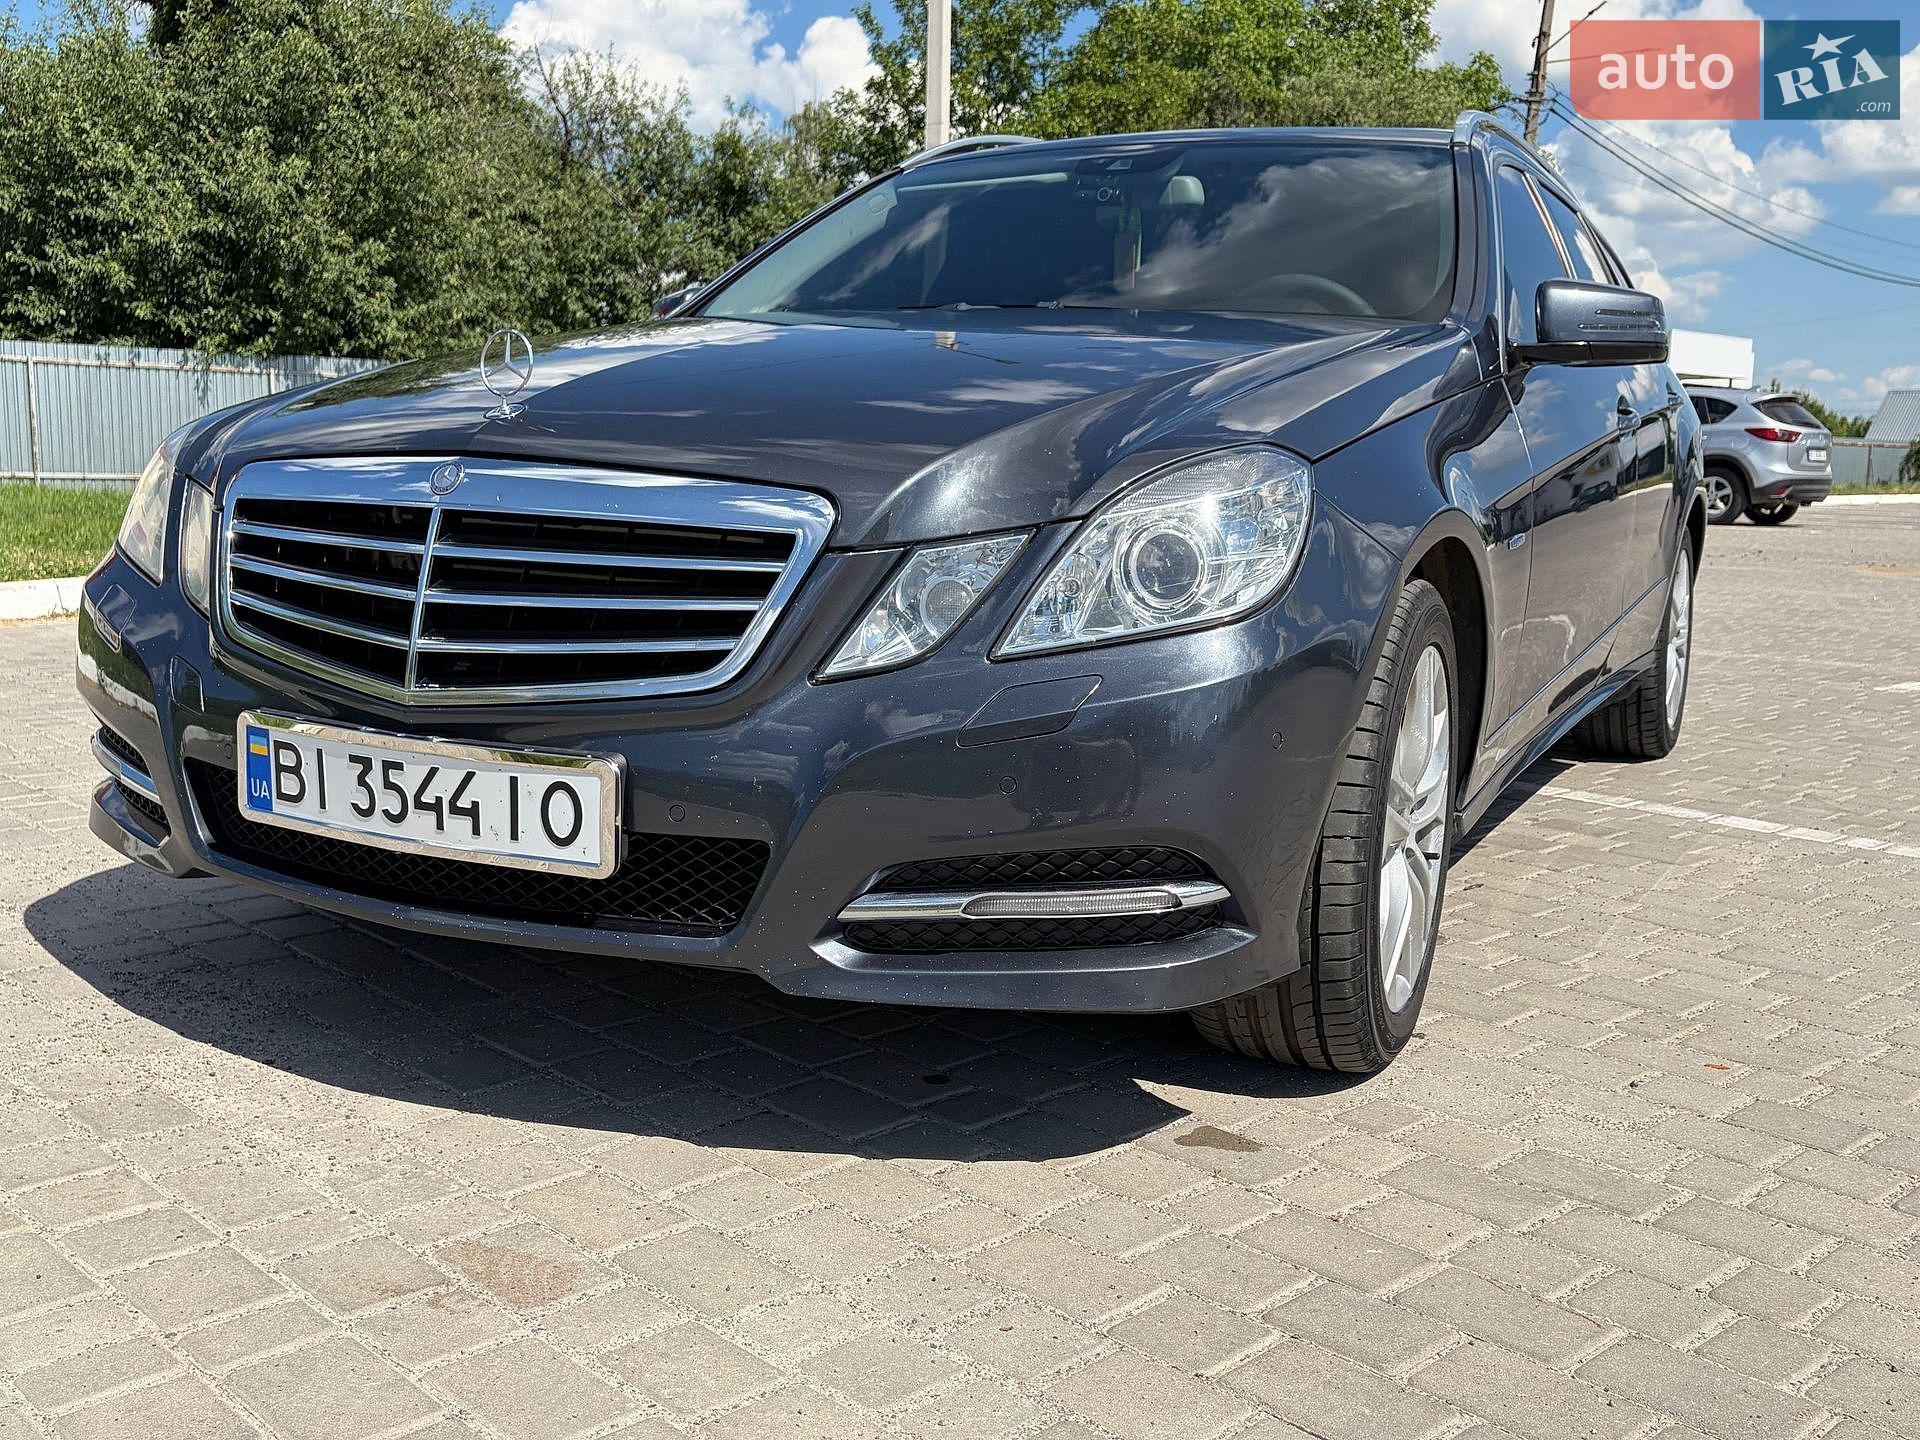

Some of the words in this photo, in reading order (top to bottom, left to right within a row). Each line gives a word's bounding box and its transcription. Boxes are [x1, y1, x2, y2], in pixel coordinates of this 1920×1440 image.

[251, 778, 270, 800] UA
[273, 740, 328, 808] BI
[347, 754, 481, 836] 3544
